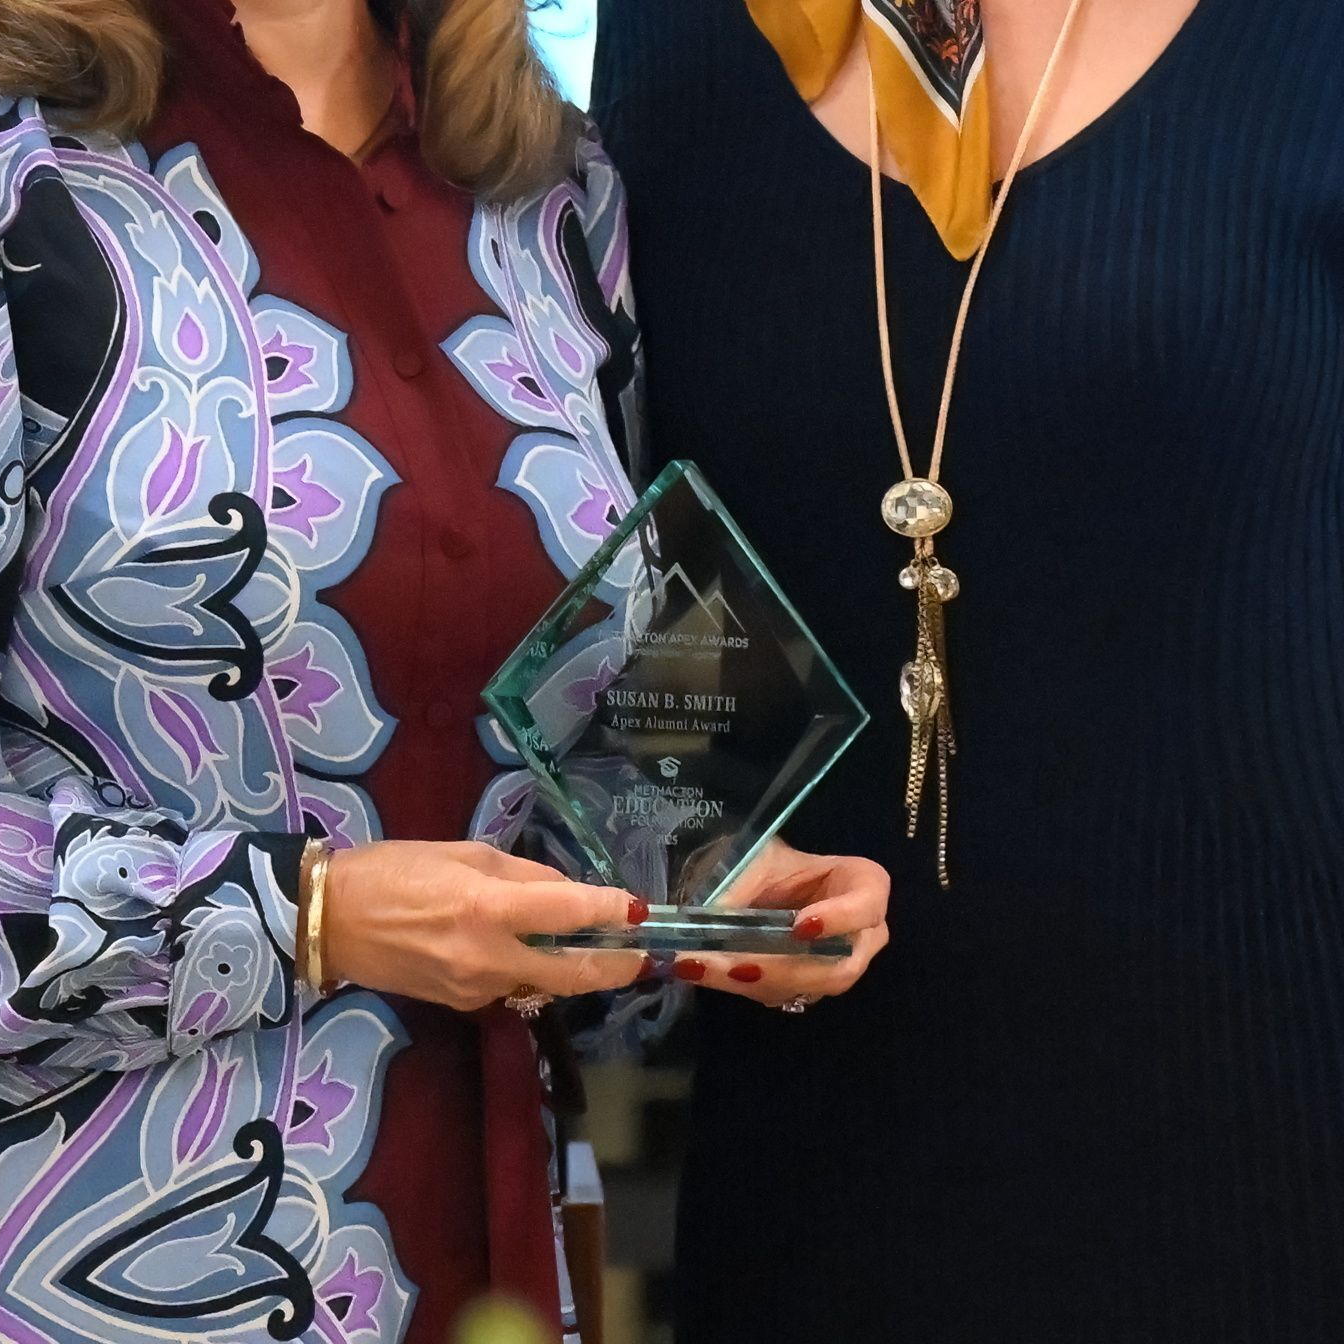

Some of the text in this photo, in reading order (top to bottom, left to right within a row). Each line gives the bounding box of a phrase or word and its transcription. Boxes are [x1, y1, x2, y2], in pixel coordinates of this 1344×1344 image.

[701, 635, 750, 649] AWARDS
[607, 690, 736, 712] SUSAN B. SMITH
[611, 714, 731, 733] Apex Alumni Award
[634, 784, 704, 798] METHACTON
[613, 795, 724, 818] EDUCON
[631, 814, 705, 829] FOUION
